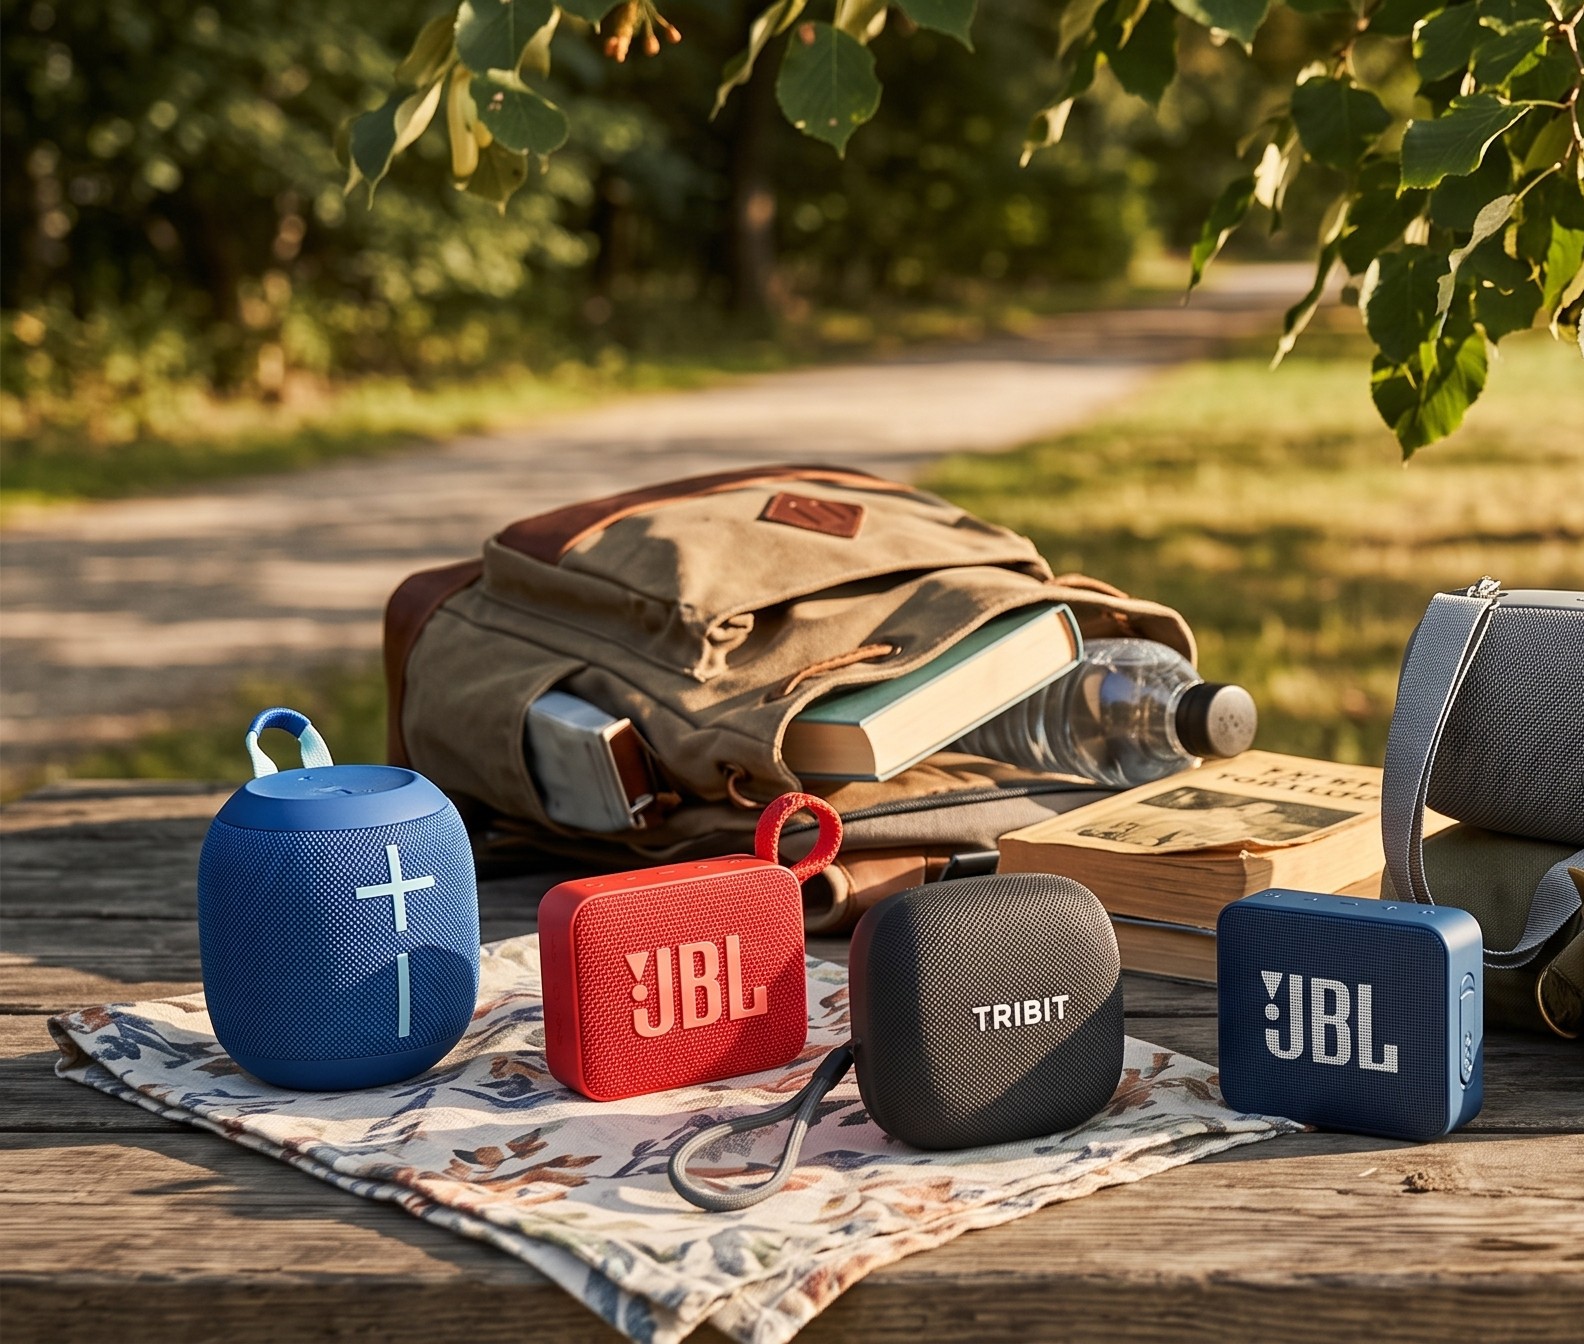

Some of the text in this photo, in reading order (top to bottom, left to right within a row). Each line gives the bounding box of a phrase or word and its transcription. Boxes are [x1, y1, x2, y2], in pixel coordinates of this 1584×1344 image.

[625, 934, 768, 1038] JBL
[972, 994, 1069, 1032] TRIBIT
[1260, 970, 1398, 1073] JBL
